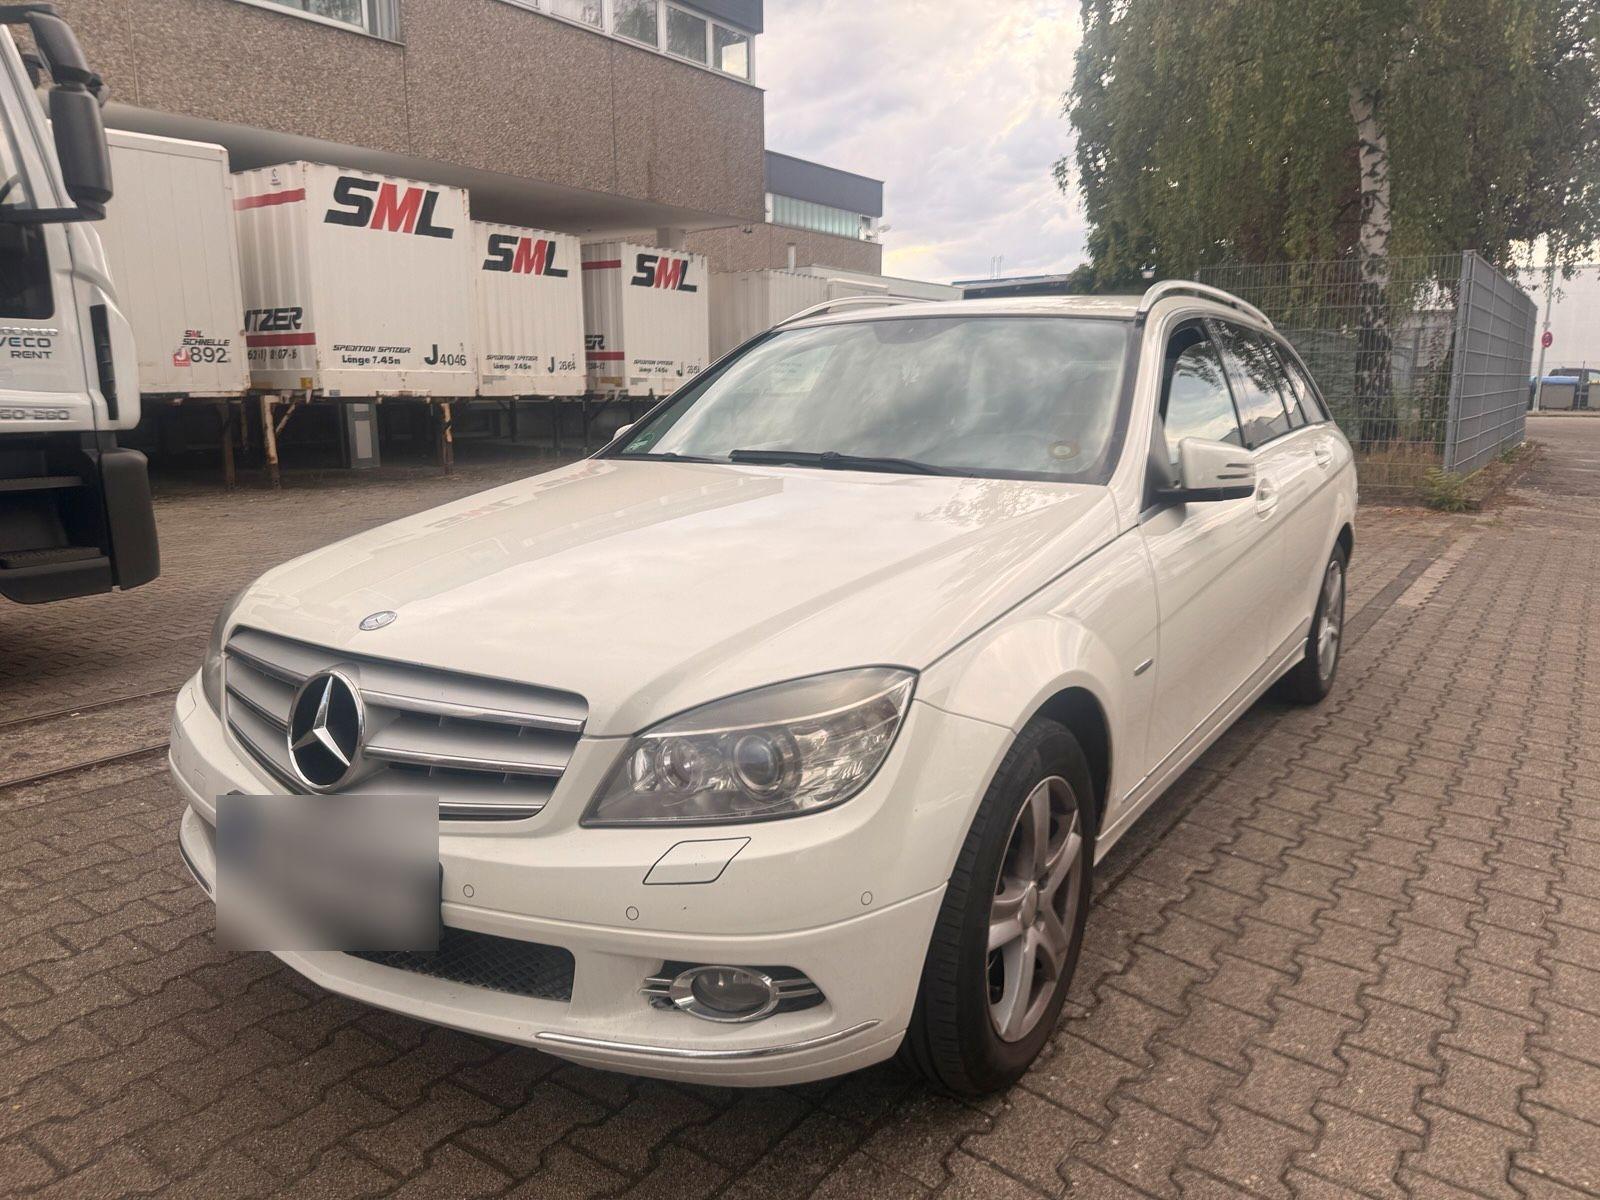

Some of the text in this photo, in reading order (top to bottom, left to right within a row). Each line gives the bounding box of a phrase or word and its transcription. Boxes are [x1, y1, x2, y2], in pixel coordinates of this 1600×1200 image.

[323, 176, 454, 239] SML
[482, 233, 568, 278] SML
[630, 253, 698, 293] SML
[184, 329, 204, 338] SML
[182, 338, 230, 347] SCHNELLE
[11, 350, 52, 359] RENT
[190, 346, 228, 363] 892
[333, 344, 411, 354] SPEDITION SPITZER
[372, 355, 400, 365] 7.45m
[440, 354, 467, 366] 4046
